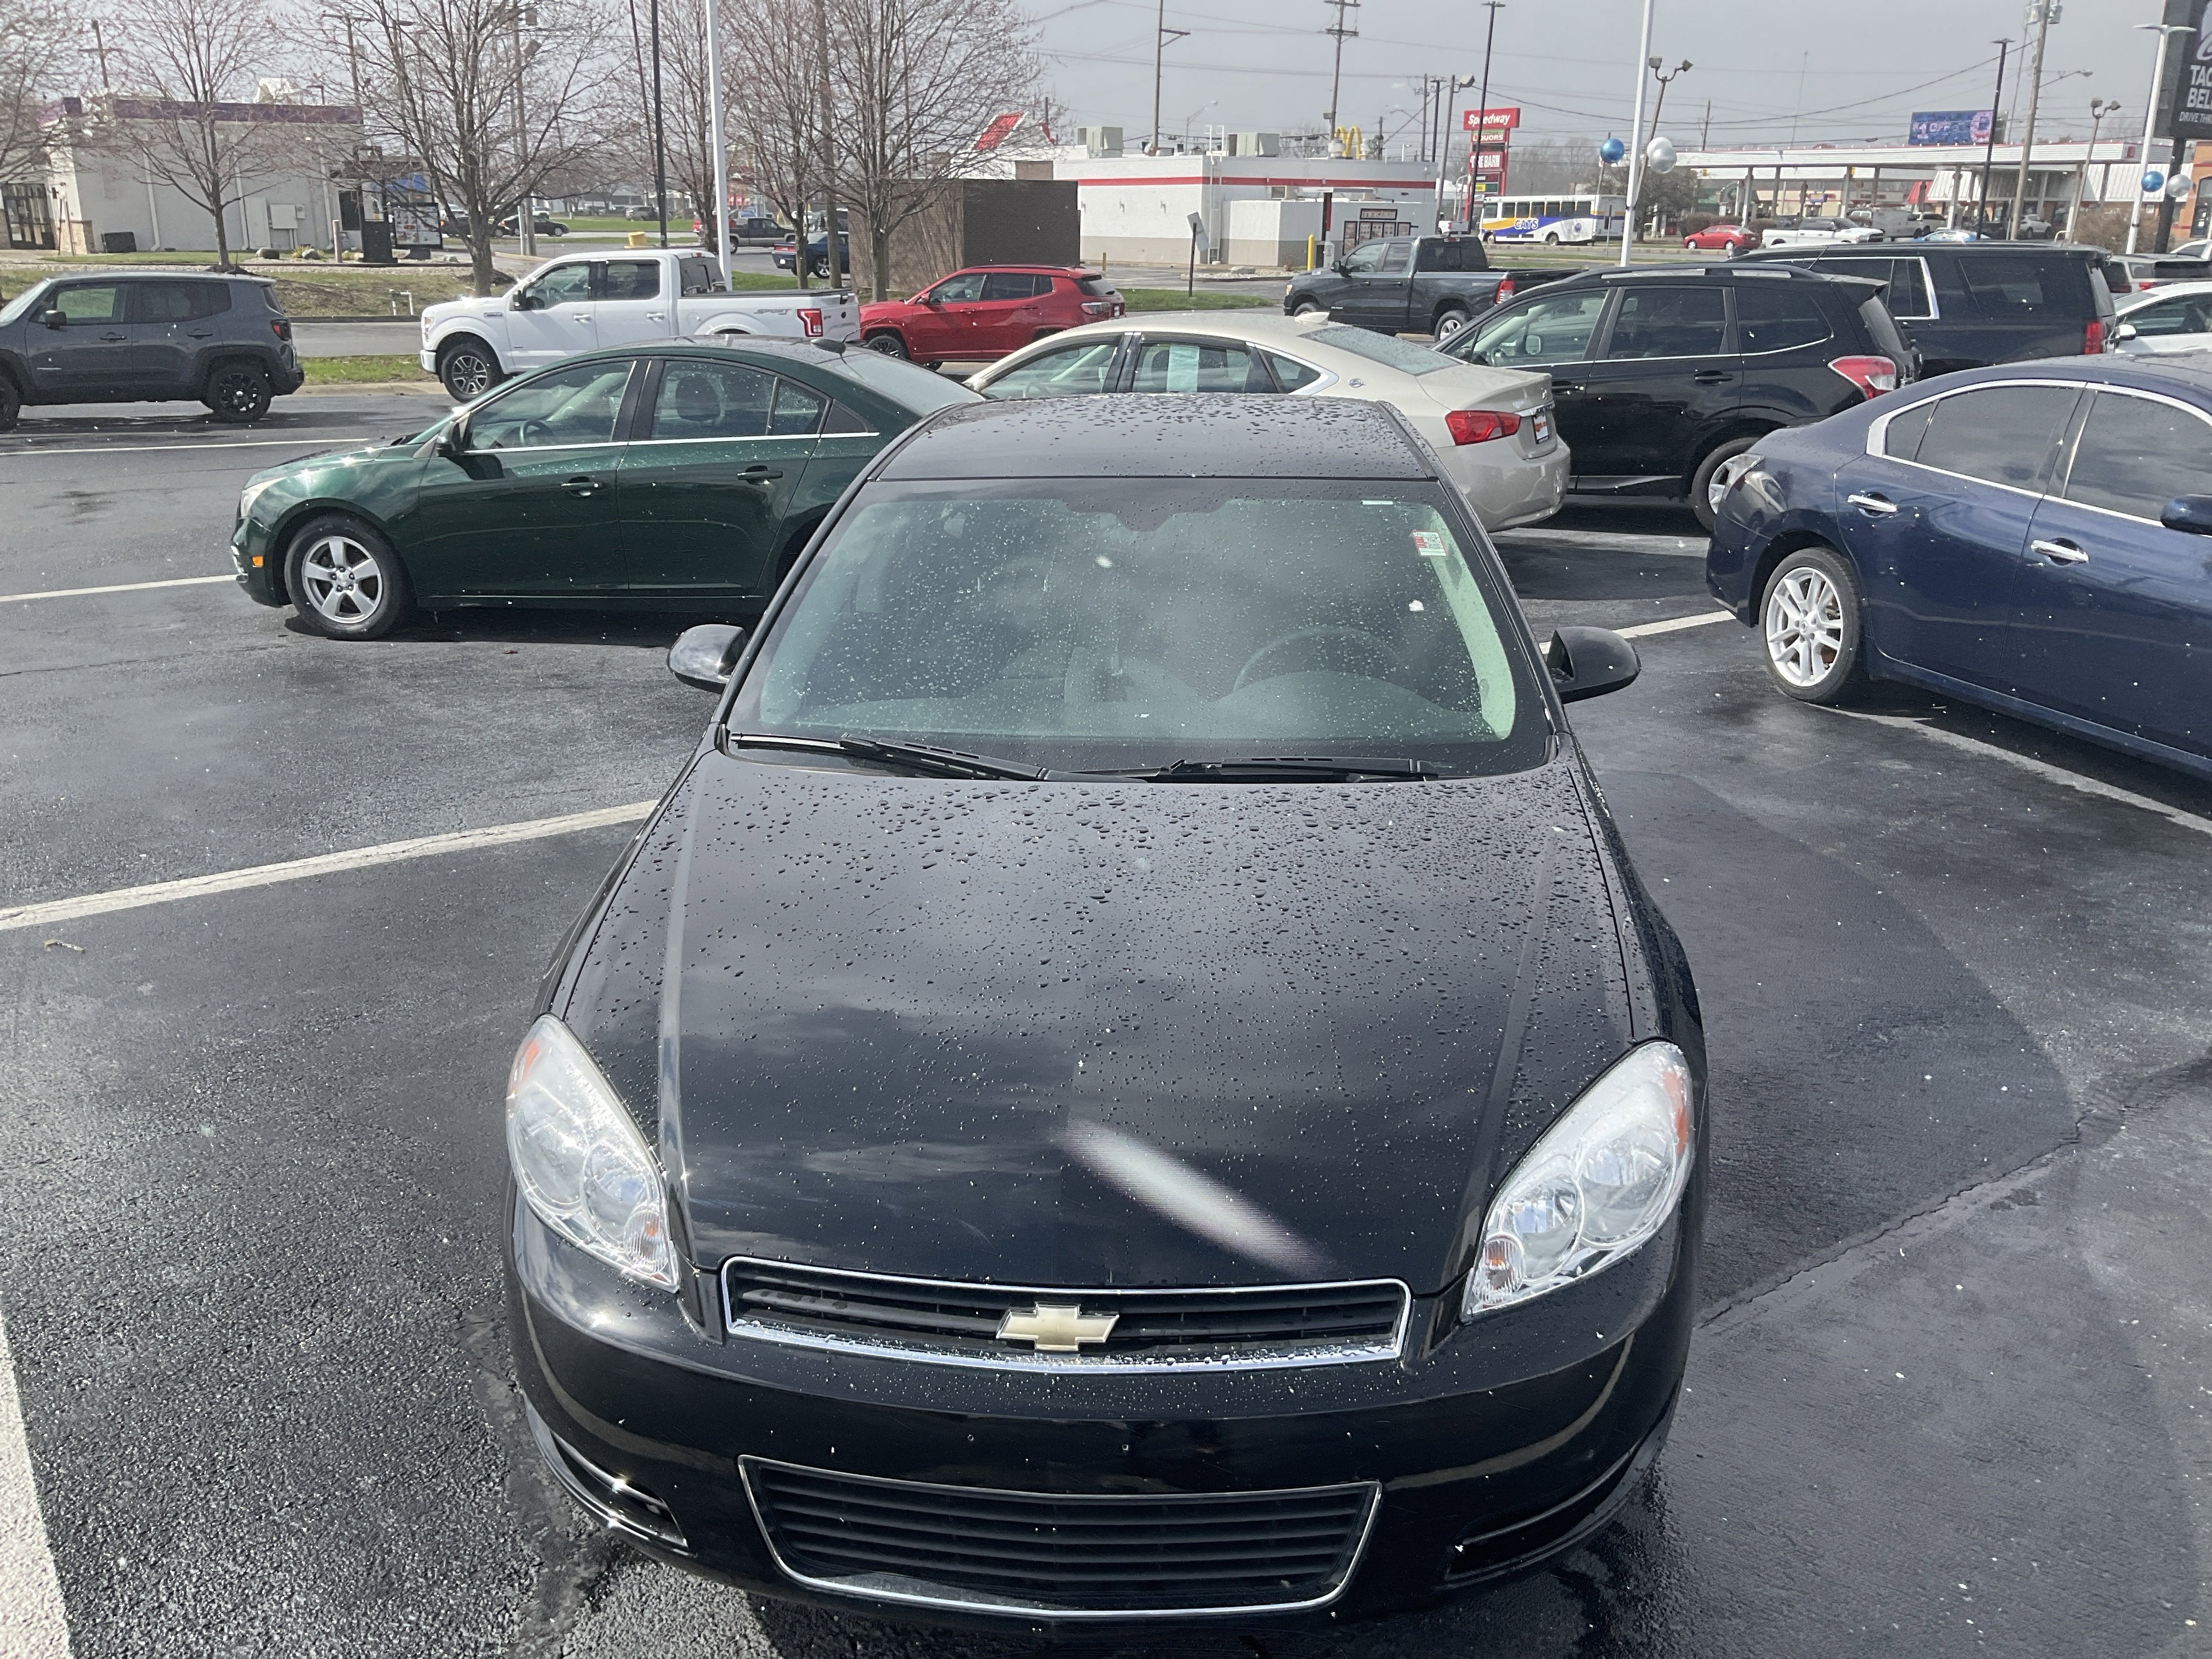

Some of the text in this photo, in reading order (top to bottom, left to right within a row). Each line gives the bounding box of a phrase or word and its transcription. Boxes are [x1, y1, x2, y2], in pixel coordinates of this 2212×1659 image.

[2187, 87, 2212, 109] BEL
[1468, 113, 1510, 127] Spedway
[2179, 111, 2199, 122] DRIVE
[1470, 154, 1500, 168] TRE BARN
[1515, 219, 1538, 229] CATS
